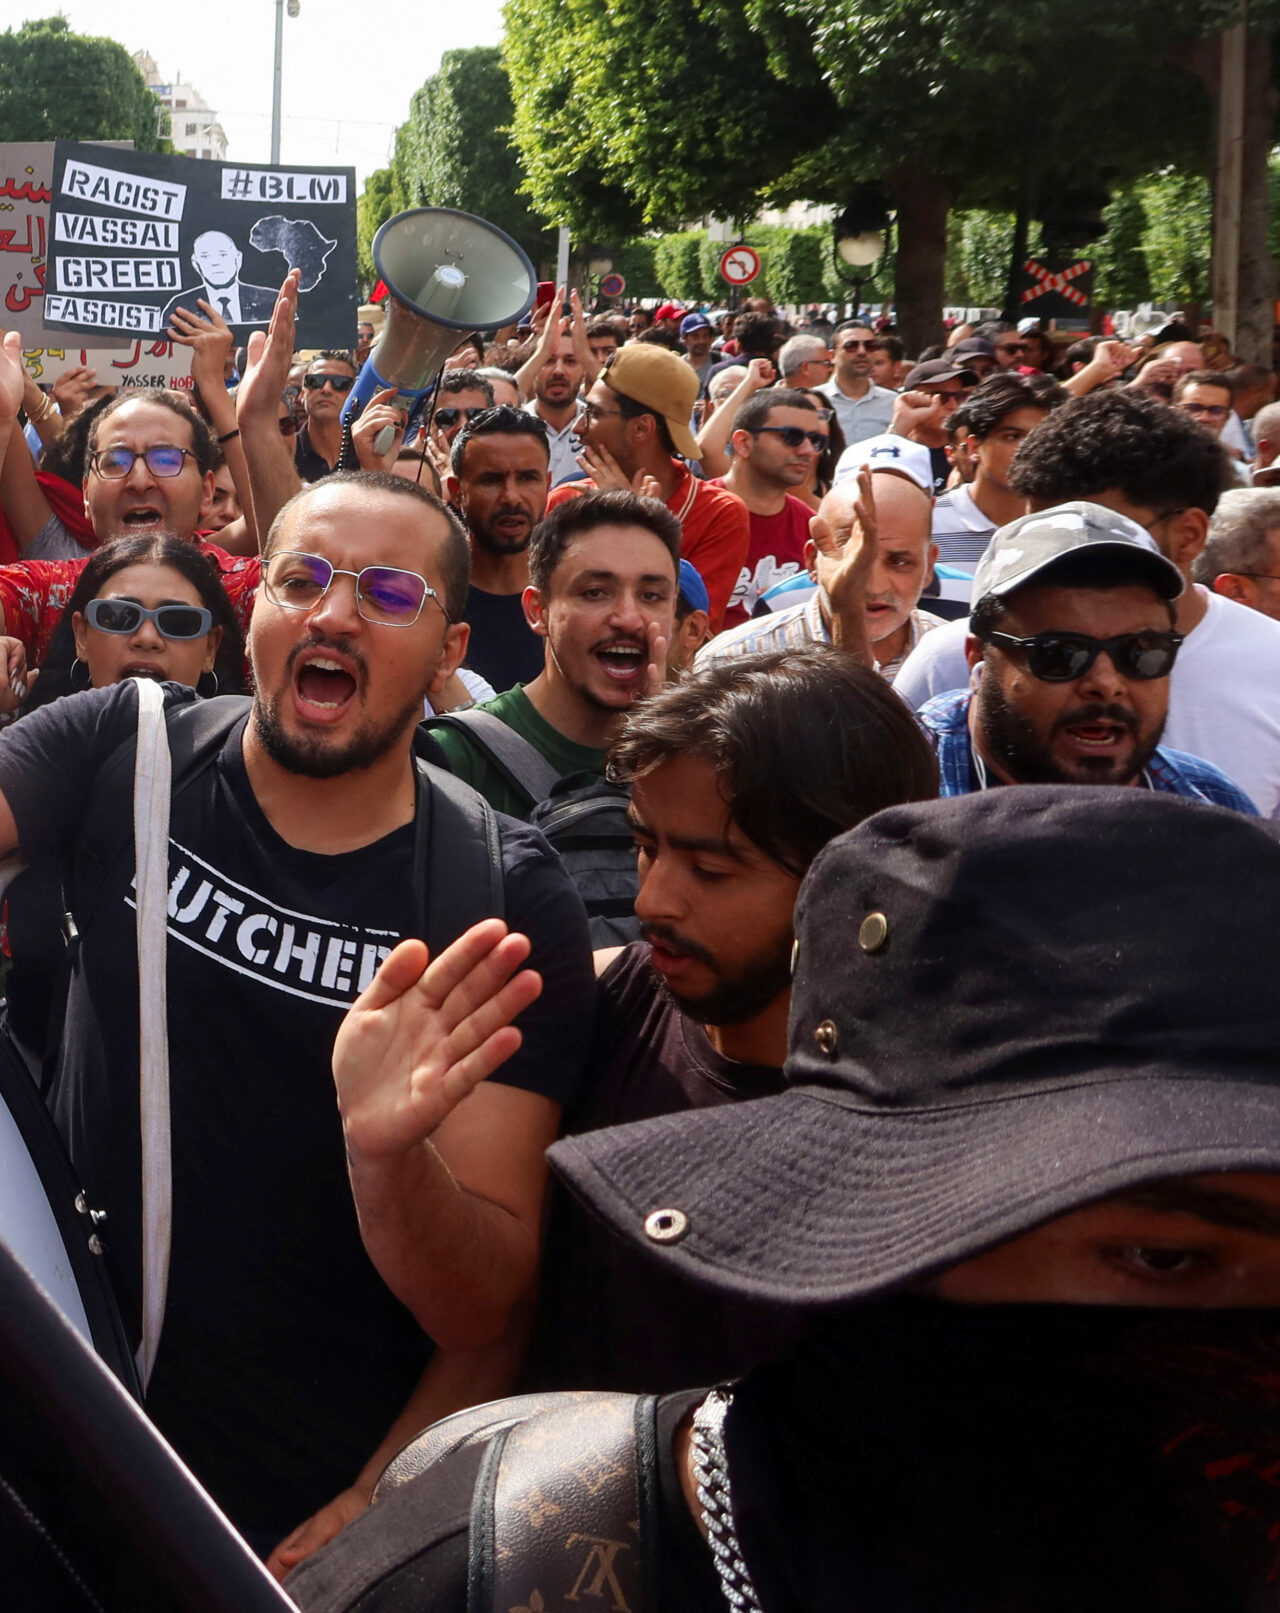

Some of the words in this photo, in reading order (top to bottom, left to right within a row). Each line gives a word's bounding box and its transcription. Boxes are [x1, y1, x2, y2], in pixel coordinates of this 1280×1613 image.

[68, 168, 179, 215] RACIST
[228, 169, 341, 201] #BLM
[61, 213, 172, 249] VASSAL
[62, 258, 178, 288] GREED
[46, 296, 160, 331] FASCIST
[121, 374, 166, 388] YASSER
